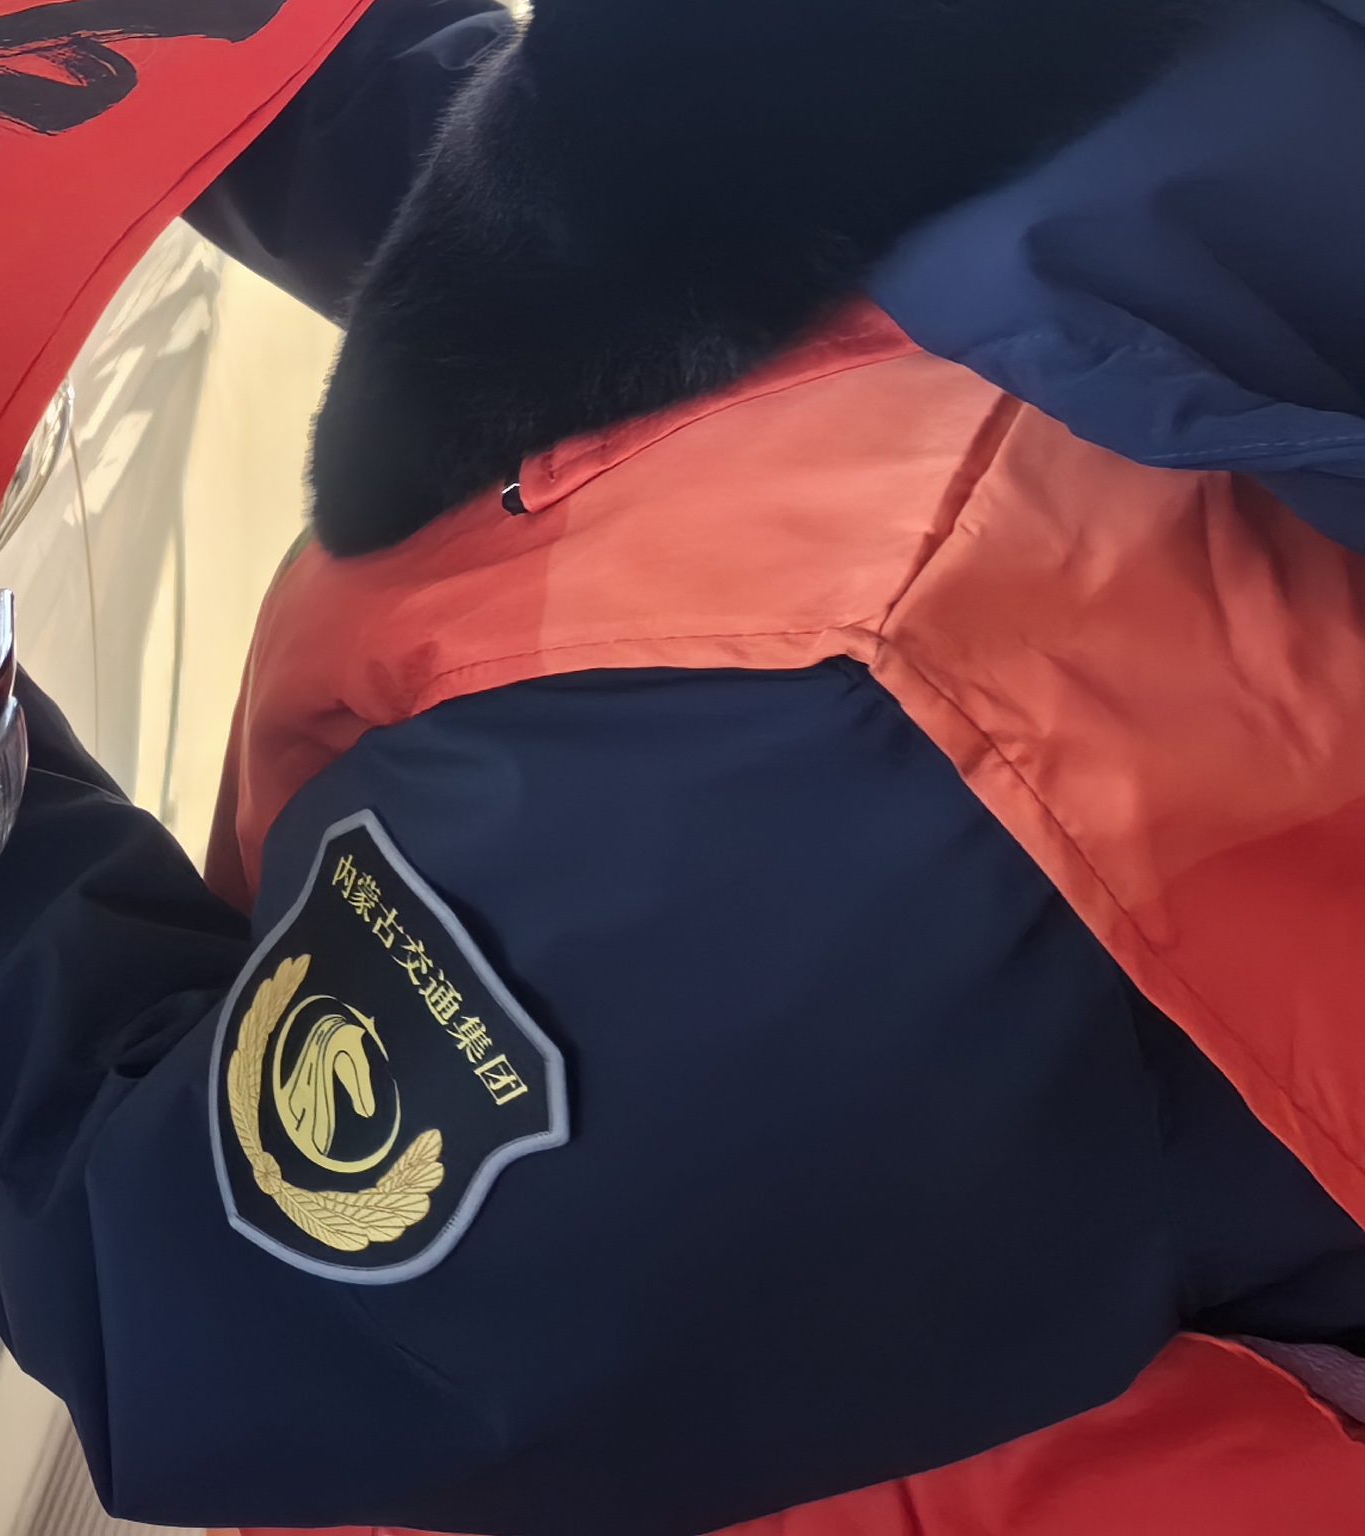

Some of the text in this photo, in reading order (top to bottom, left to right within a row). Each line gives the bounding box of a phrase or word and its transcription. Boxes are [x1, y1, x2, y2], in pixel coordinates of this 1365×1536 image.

[331, 853, 529, 1106] 内蒙古交通集团
